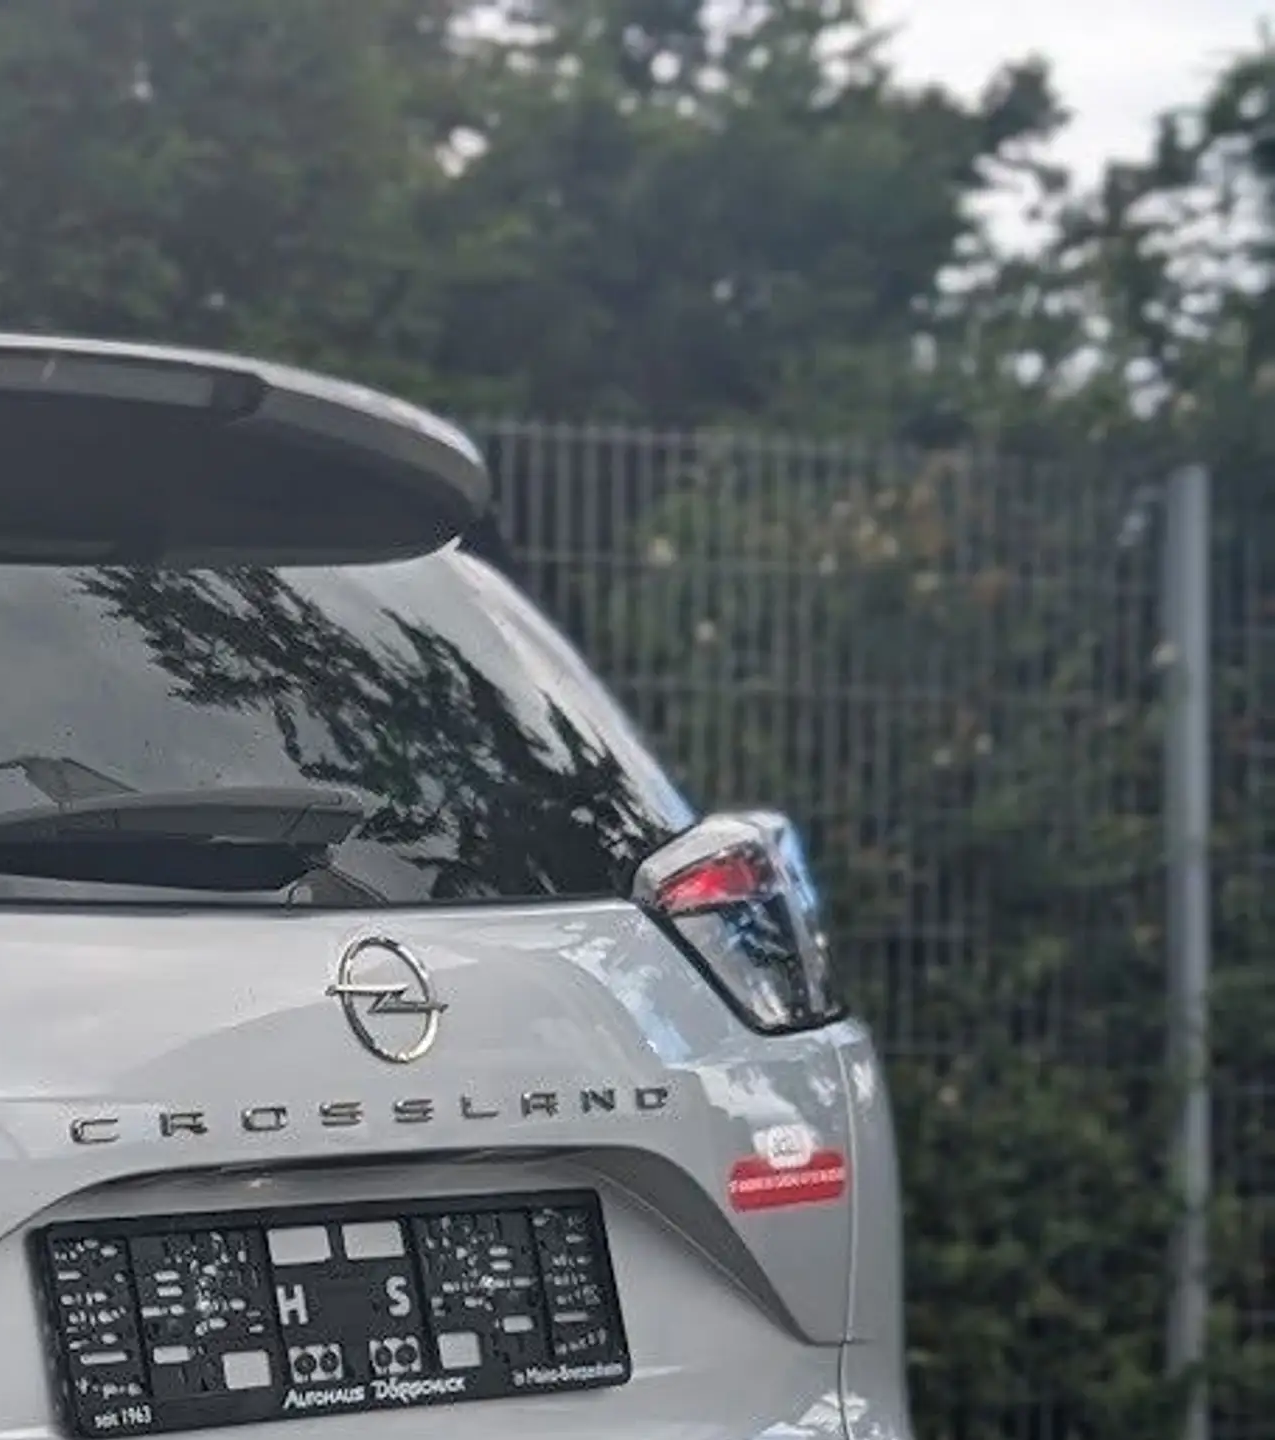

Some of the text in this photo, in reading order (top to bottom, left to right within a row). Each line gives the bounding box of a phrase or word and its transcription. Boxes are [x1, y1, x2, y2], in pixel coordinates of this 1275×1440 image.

[69, 1085, 669, 1145] CROSSLAND
[276, 1275, 412, 1325] H S
